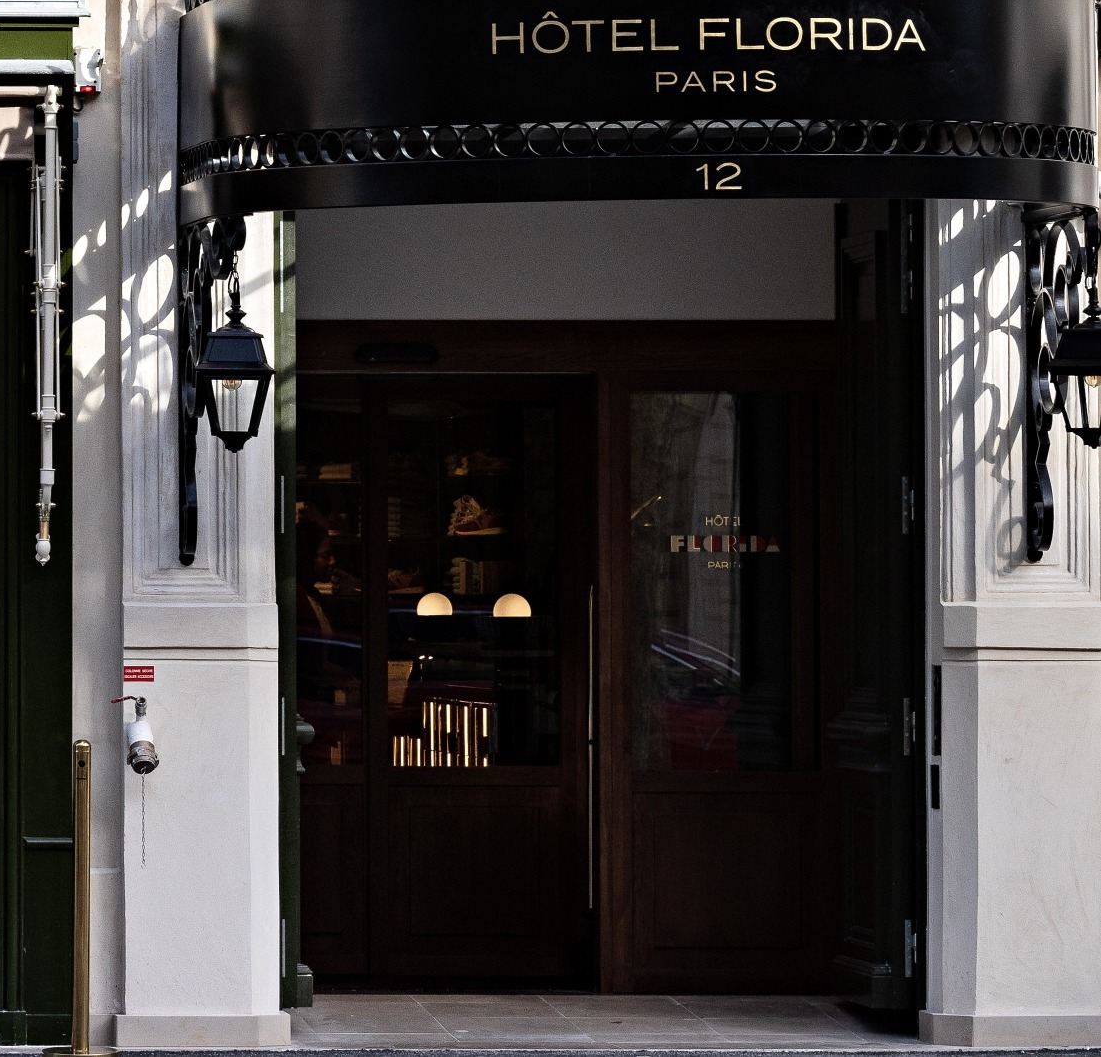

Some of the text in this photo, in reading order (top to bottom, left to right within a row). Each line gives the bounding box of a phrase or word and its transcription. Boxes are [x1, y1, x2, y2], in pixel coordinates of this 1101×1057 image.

[491, 11, 926, 55] HÔTEL FLORIDA
[655, 70, 777, 93] PARIS
[696, 163, 742, 191] 12
[670, 535, 780, 552] FLORIDA
